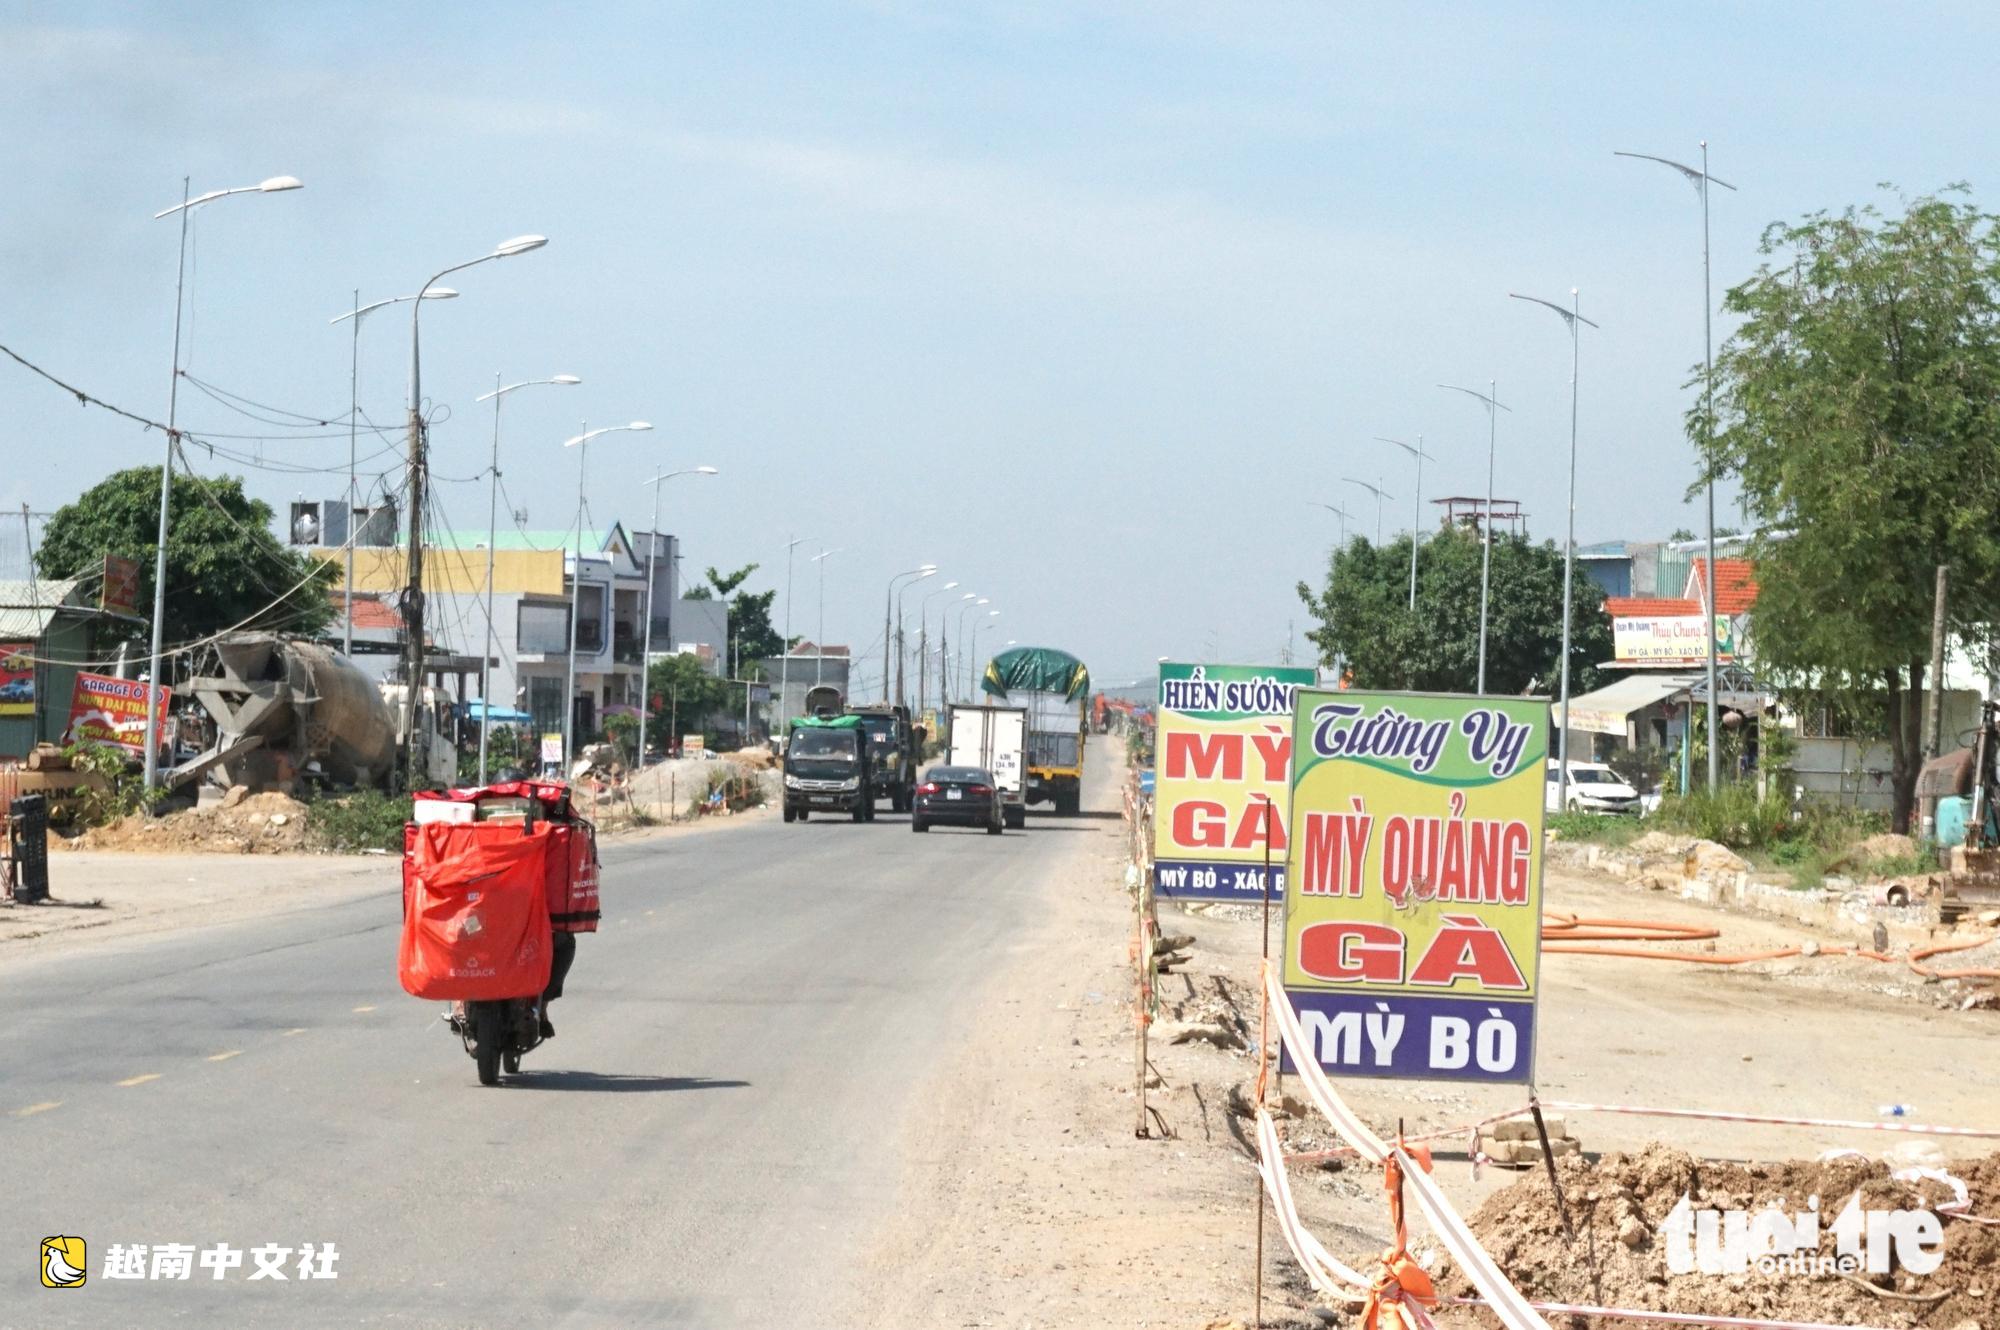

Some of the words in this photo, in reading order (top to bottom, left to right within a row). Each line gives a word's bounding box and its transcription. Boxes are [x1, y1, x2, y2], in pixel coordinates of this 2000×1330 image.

[81, 679, 130, 697] GARAGE
[1164, 668, 1221, 710] HIỀN
[1166, 725, 1291, 781] MỲ
[1314, 704, 1451, 773] Tường
[1461, 710, 1532, 776] Vy
[1172, 793, 1287, 849] GÀ
[1302, 797, 1373, 897] MỲ
[1383, 791, 1531, 908] QUẢNG
[1160, 867, 1188, 888] MỲ
[1192, 867, 1217, 889] BÒ
[1298, 913, 1528, 990] GÀ
[1300, 1002, 1405, 1067] MỲ
[1429, 1008, 1517, 1073] BÒ
